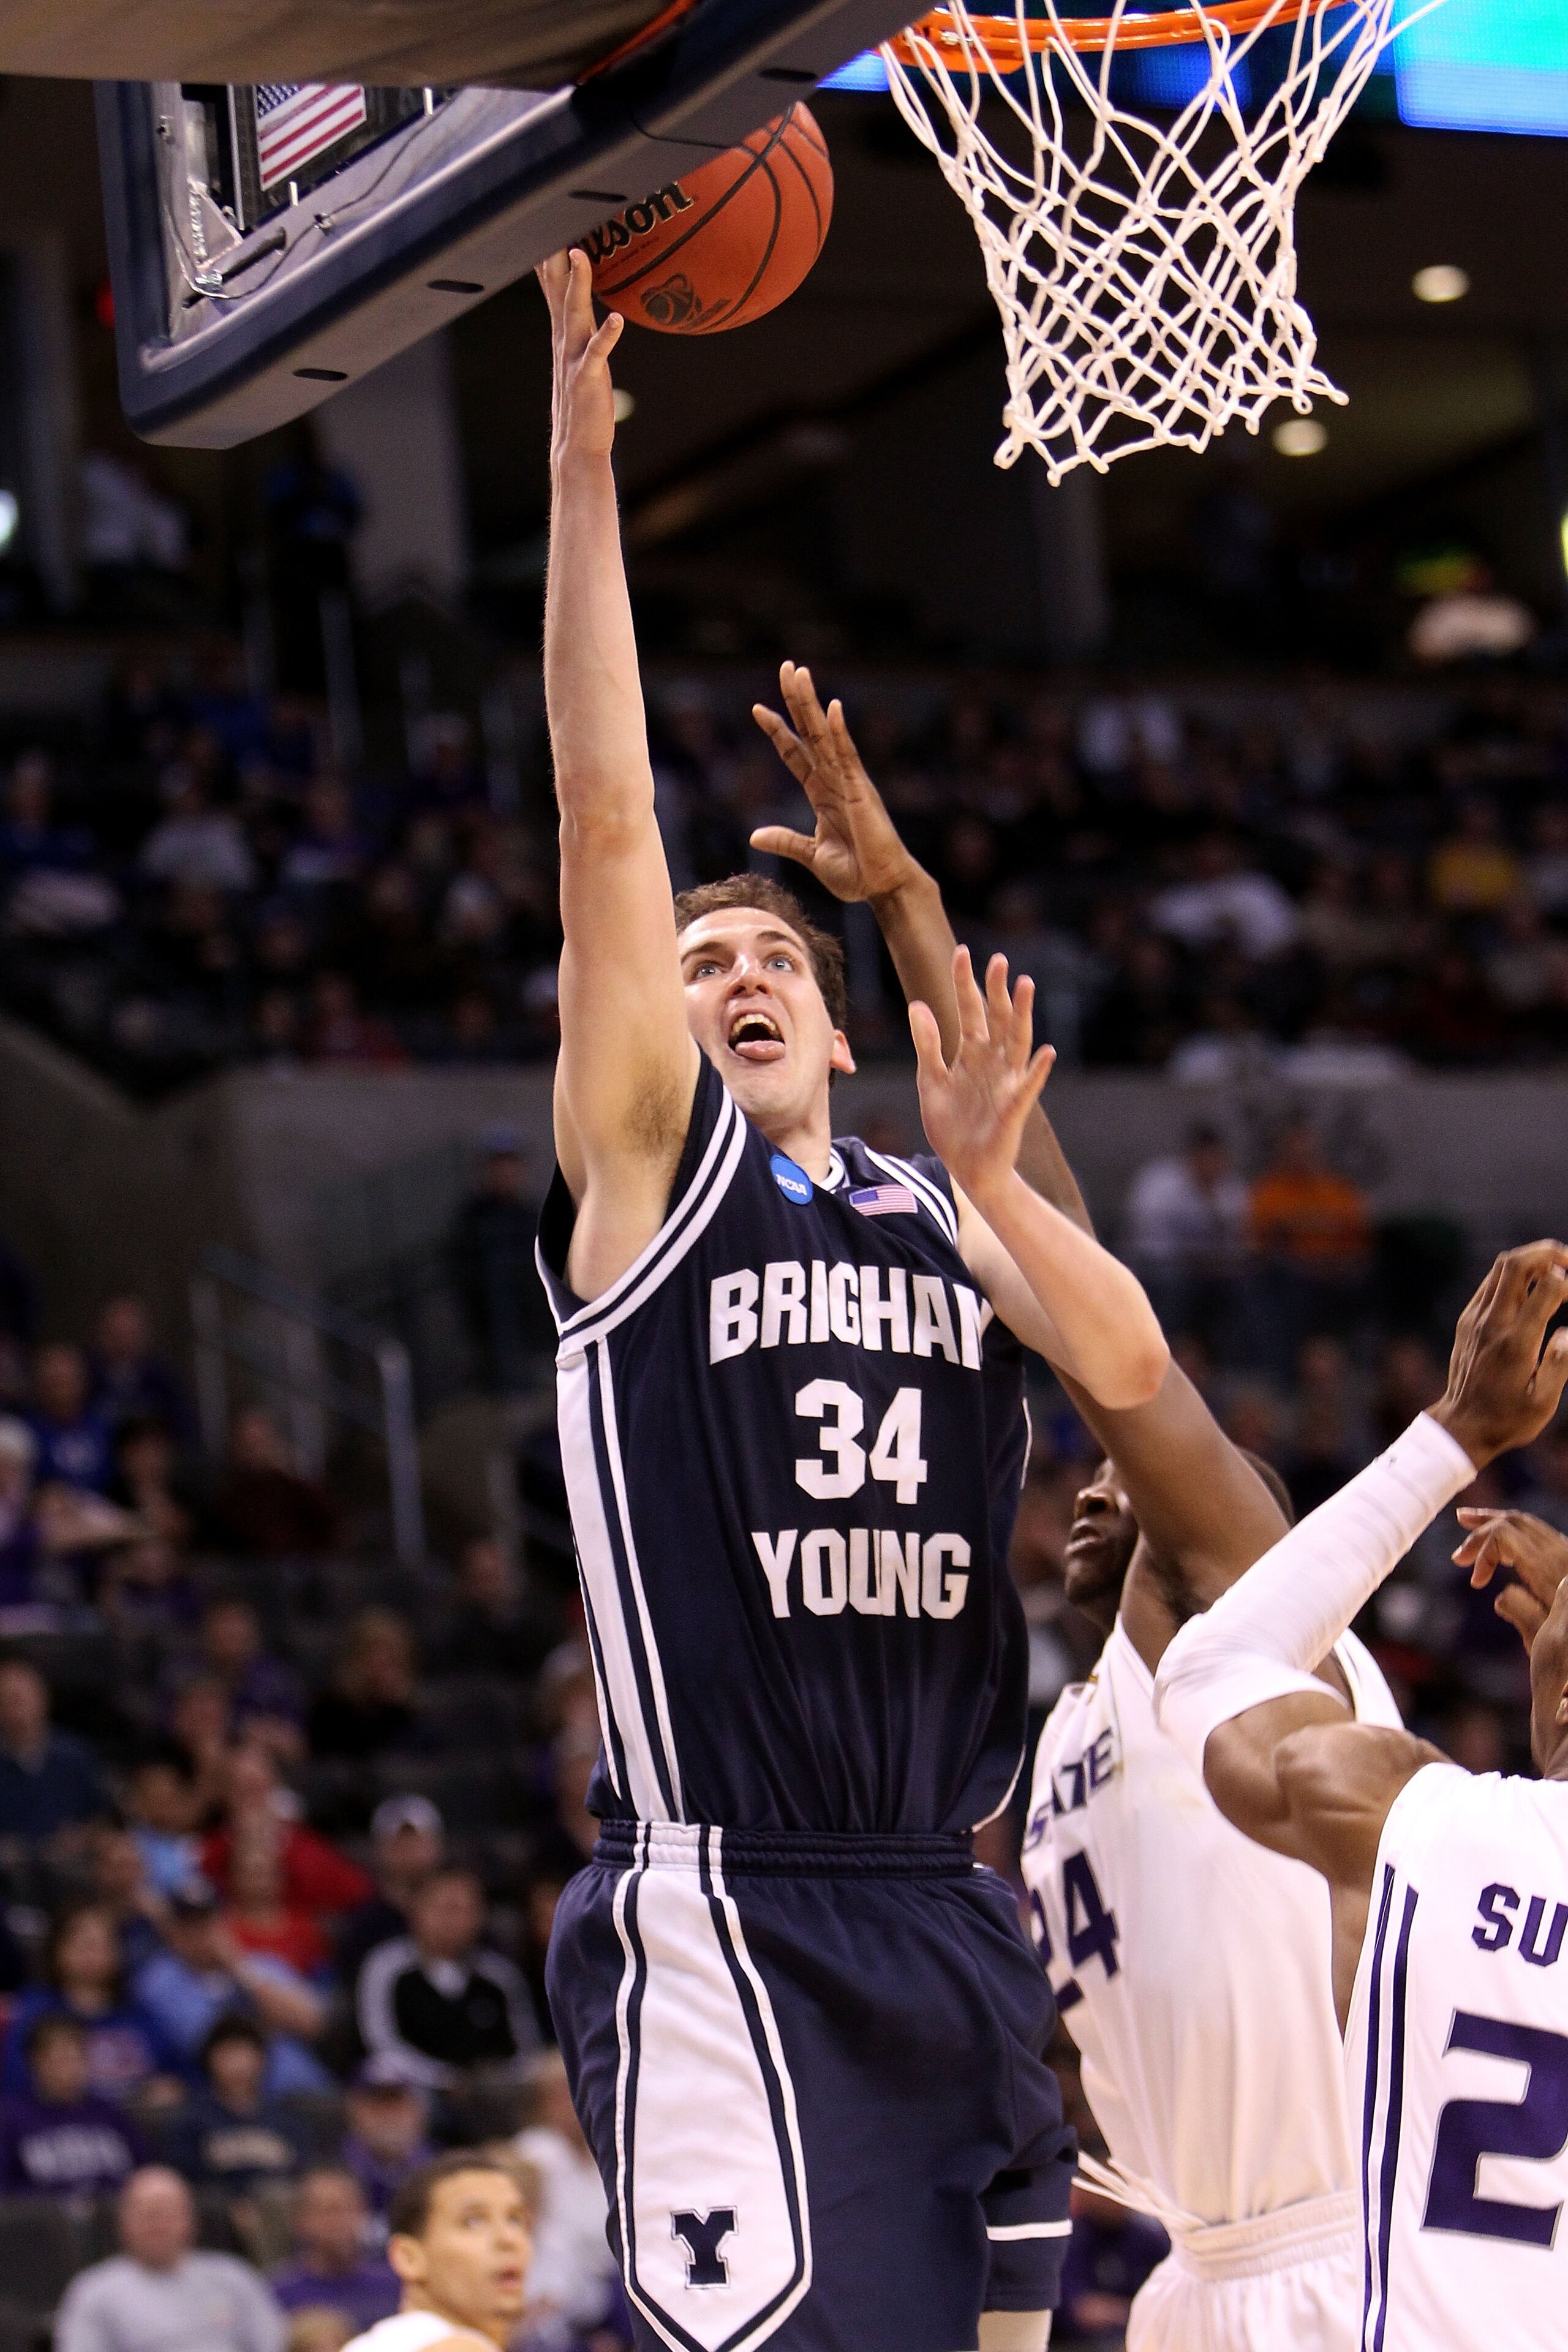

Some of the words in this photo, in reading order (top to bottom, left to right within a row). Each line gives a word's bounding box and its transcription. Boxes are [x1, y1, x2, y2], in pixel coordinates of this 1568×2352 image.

[580, 181, 694, 265] son
[774, 1174, 809, 1196] NCAA
[794, 1378, 928, 1505] 34
[751, 1528, 971, 1620] YOUNG
[671, 2206, 739, 2290] Y
